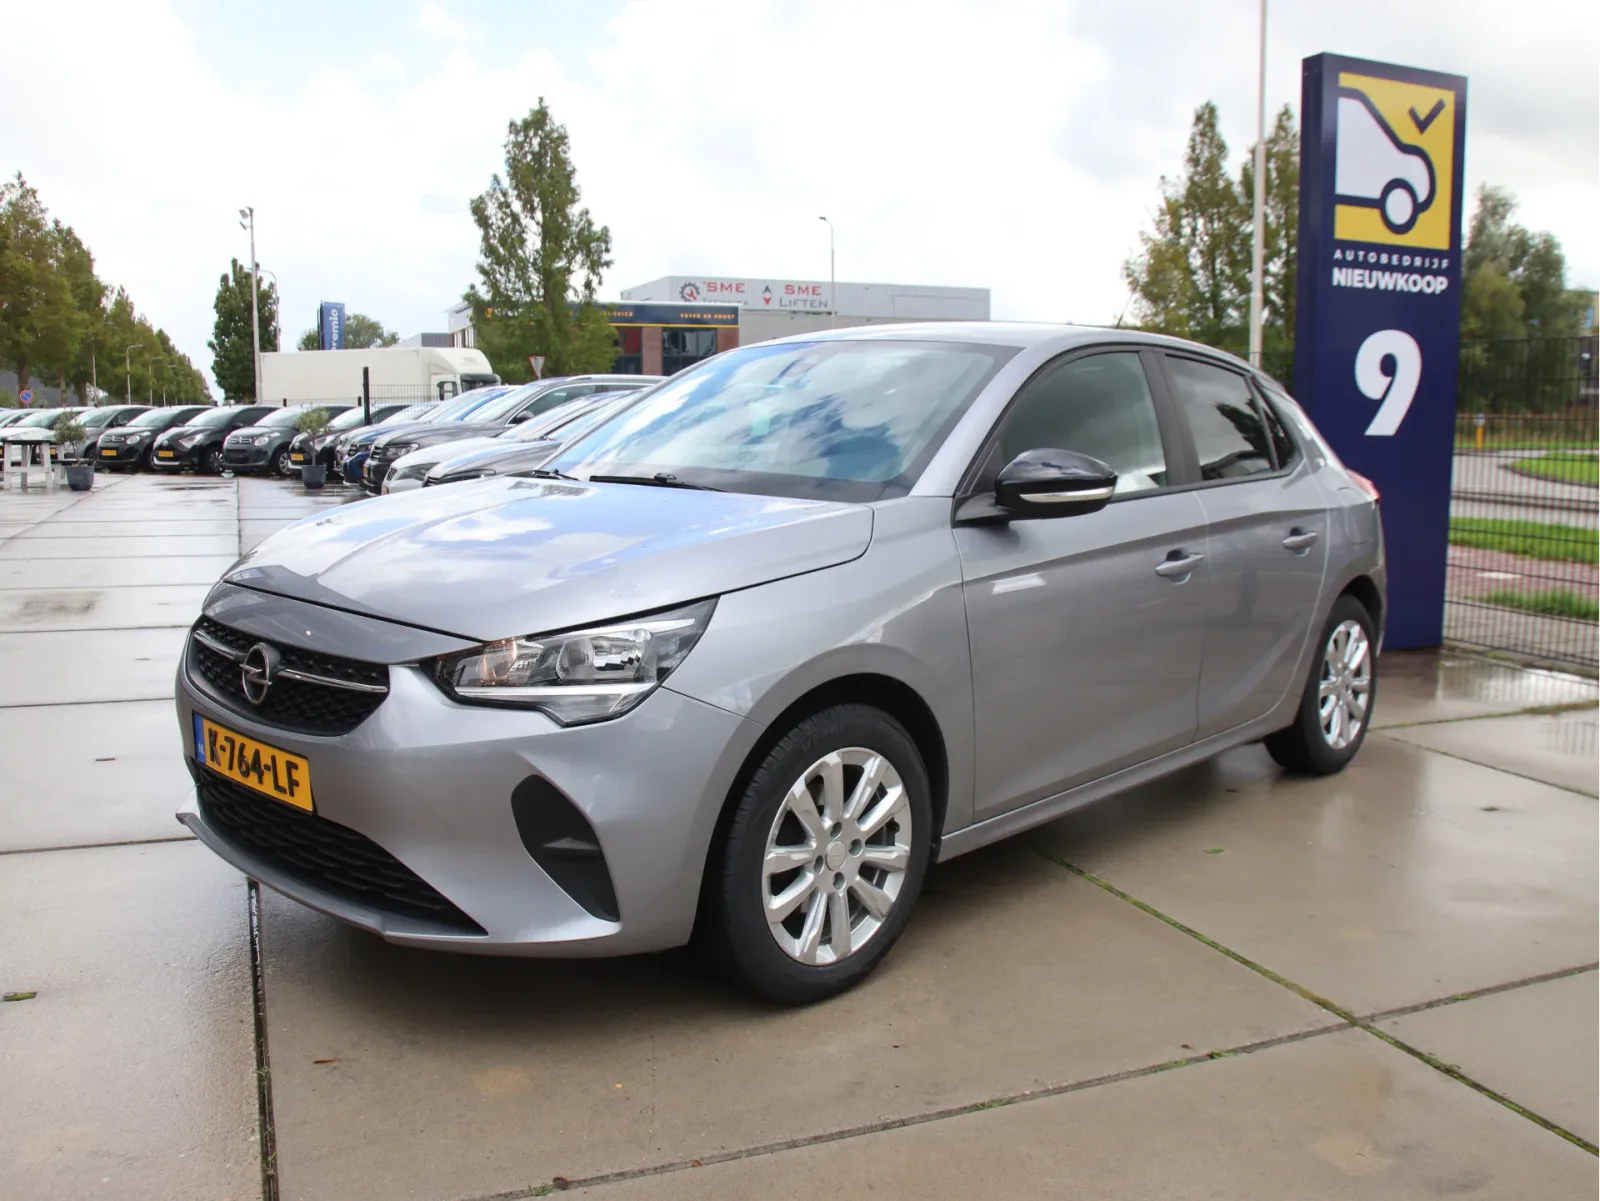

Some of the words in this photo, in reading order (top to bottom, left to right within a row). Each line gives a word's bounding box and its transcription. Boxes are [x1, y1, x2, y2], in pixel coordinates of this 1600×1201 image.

[1333, 248, 1449, 269] AUTOBEDRIJF
[707, 281, 746, 293] SME
[784, 284, 822, 296] SME
[1332, 267, 1448, 294] NIEUWKOOP
[1354, 329, 1422, 436] 9
[208, 727, 299, 797] K-764-LF
